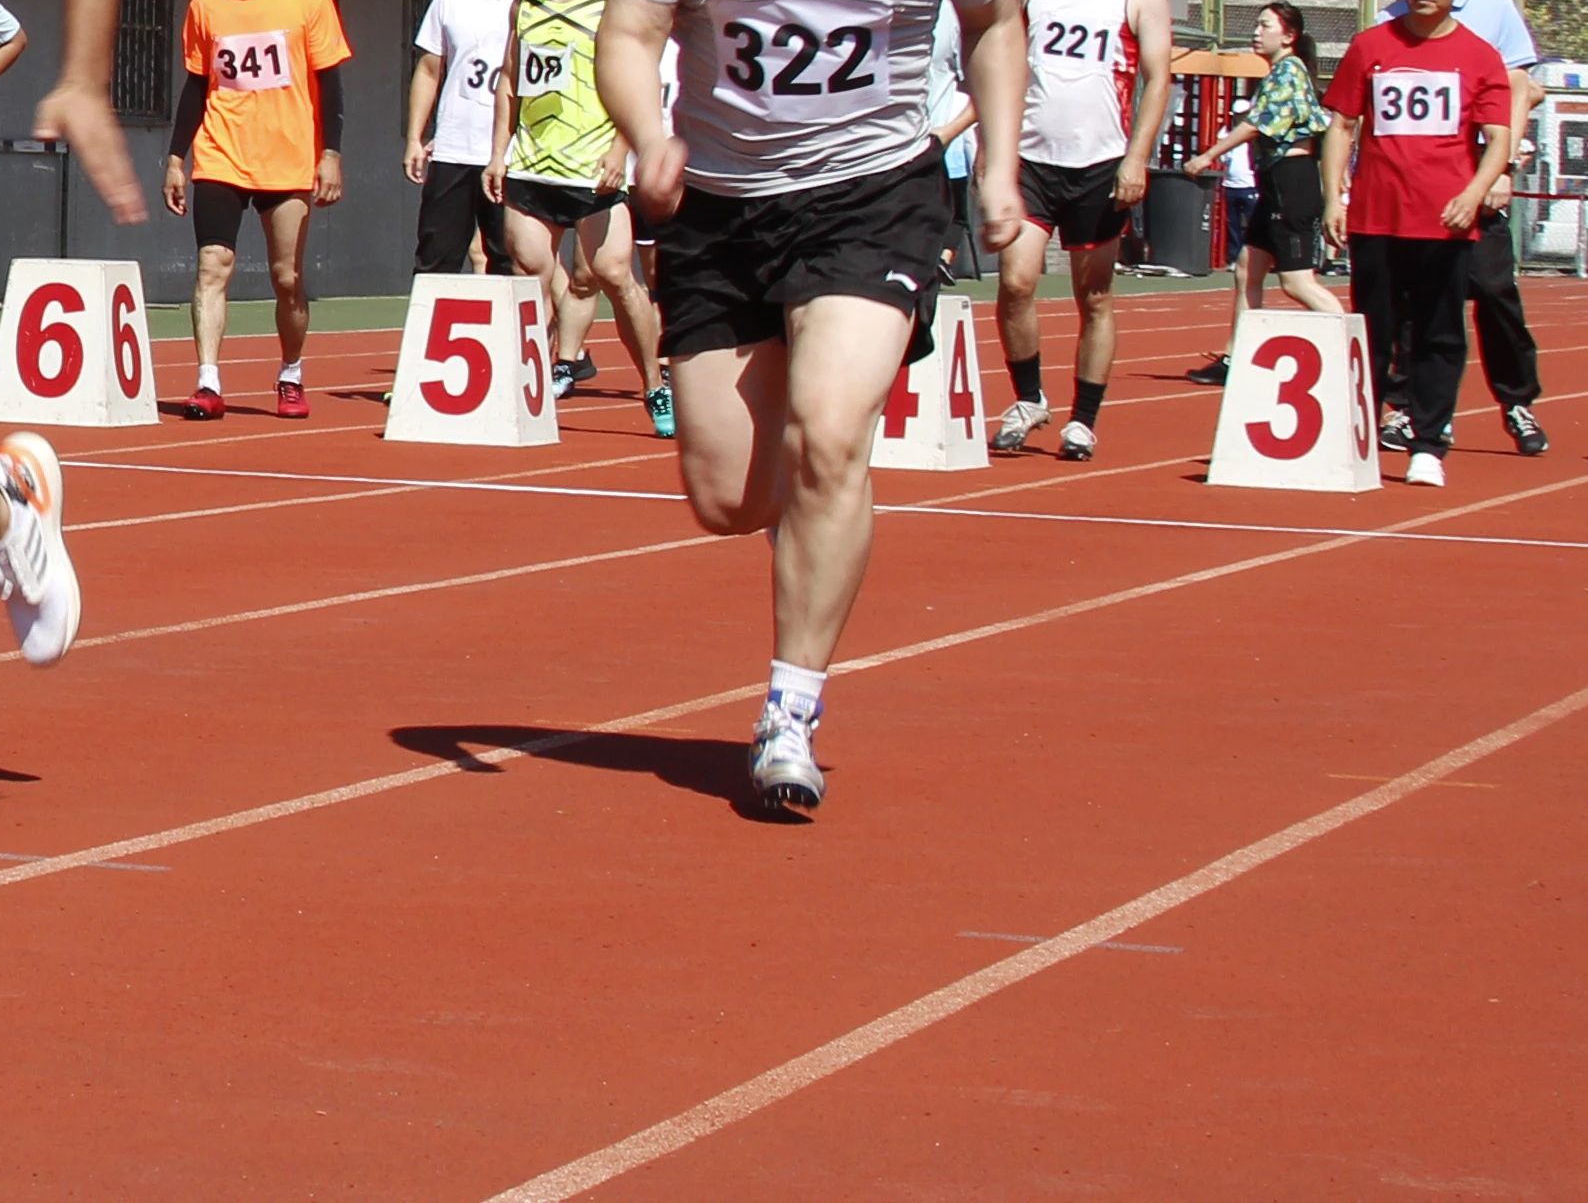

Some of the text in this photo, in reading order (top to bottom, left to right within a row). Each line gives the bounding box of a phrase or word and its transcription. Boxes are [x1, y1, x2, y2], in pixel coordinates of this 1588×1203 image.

[218, 44, 281, 79] 341
[724, 21, 874, 95] 322
[1043, 22, 1109, 62] 221
[1381, 86, 1450, 121] 361
[16, 283, 85, 398] 6
[112, 284, 142, 399] 6
[420, 298, 492, 415] 5
[519, 300, 544, 417] 5
[949, 320, 974, 439] 4
[1245, 335, 1323, 460] 3
[1350, 337, 1370, 461] 3
